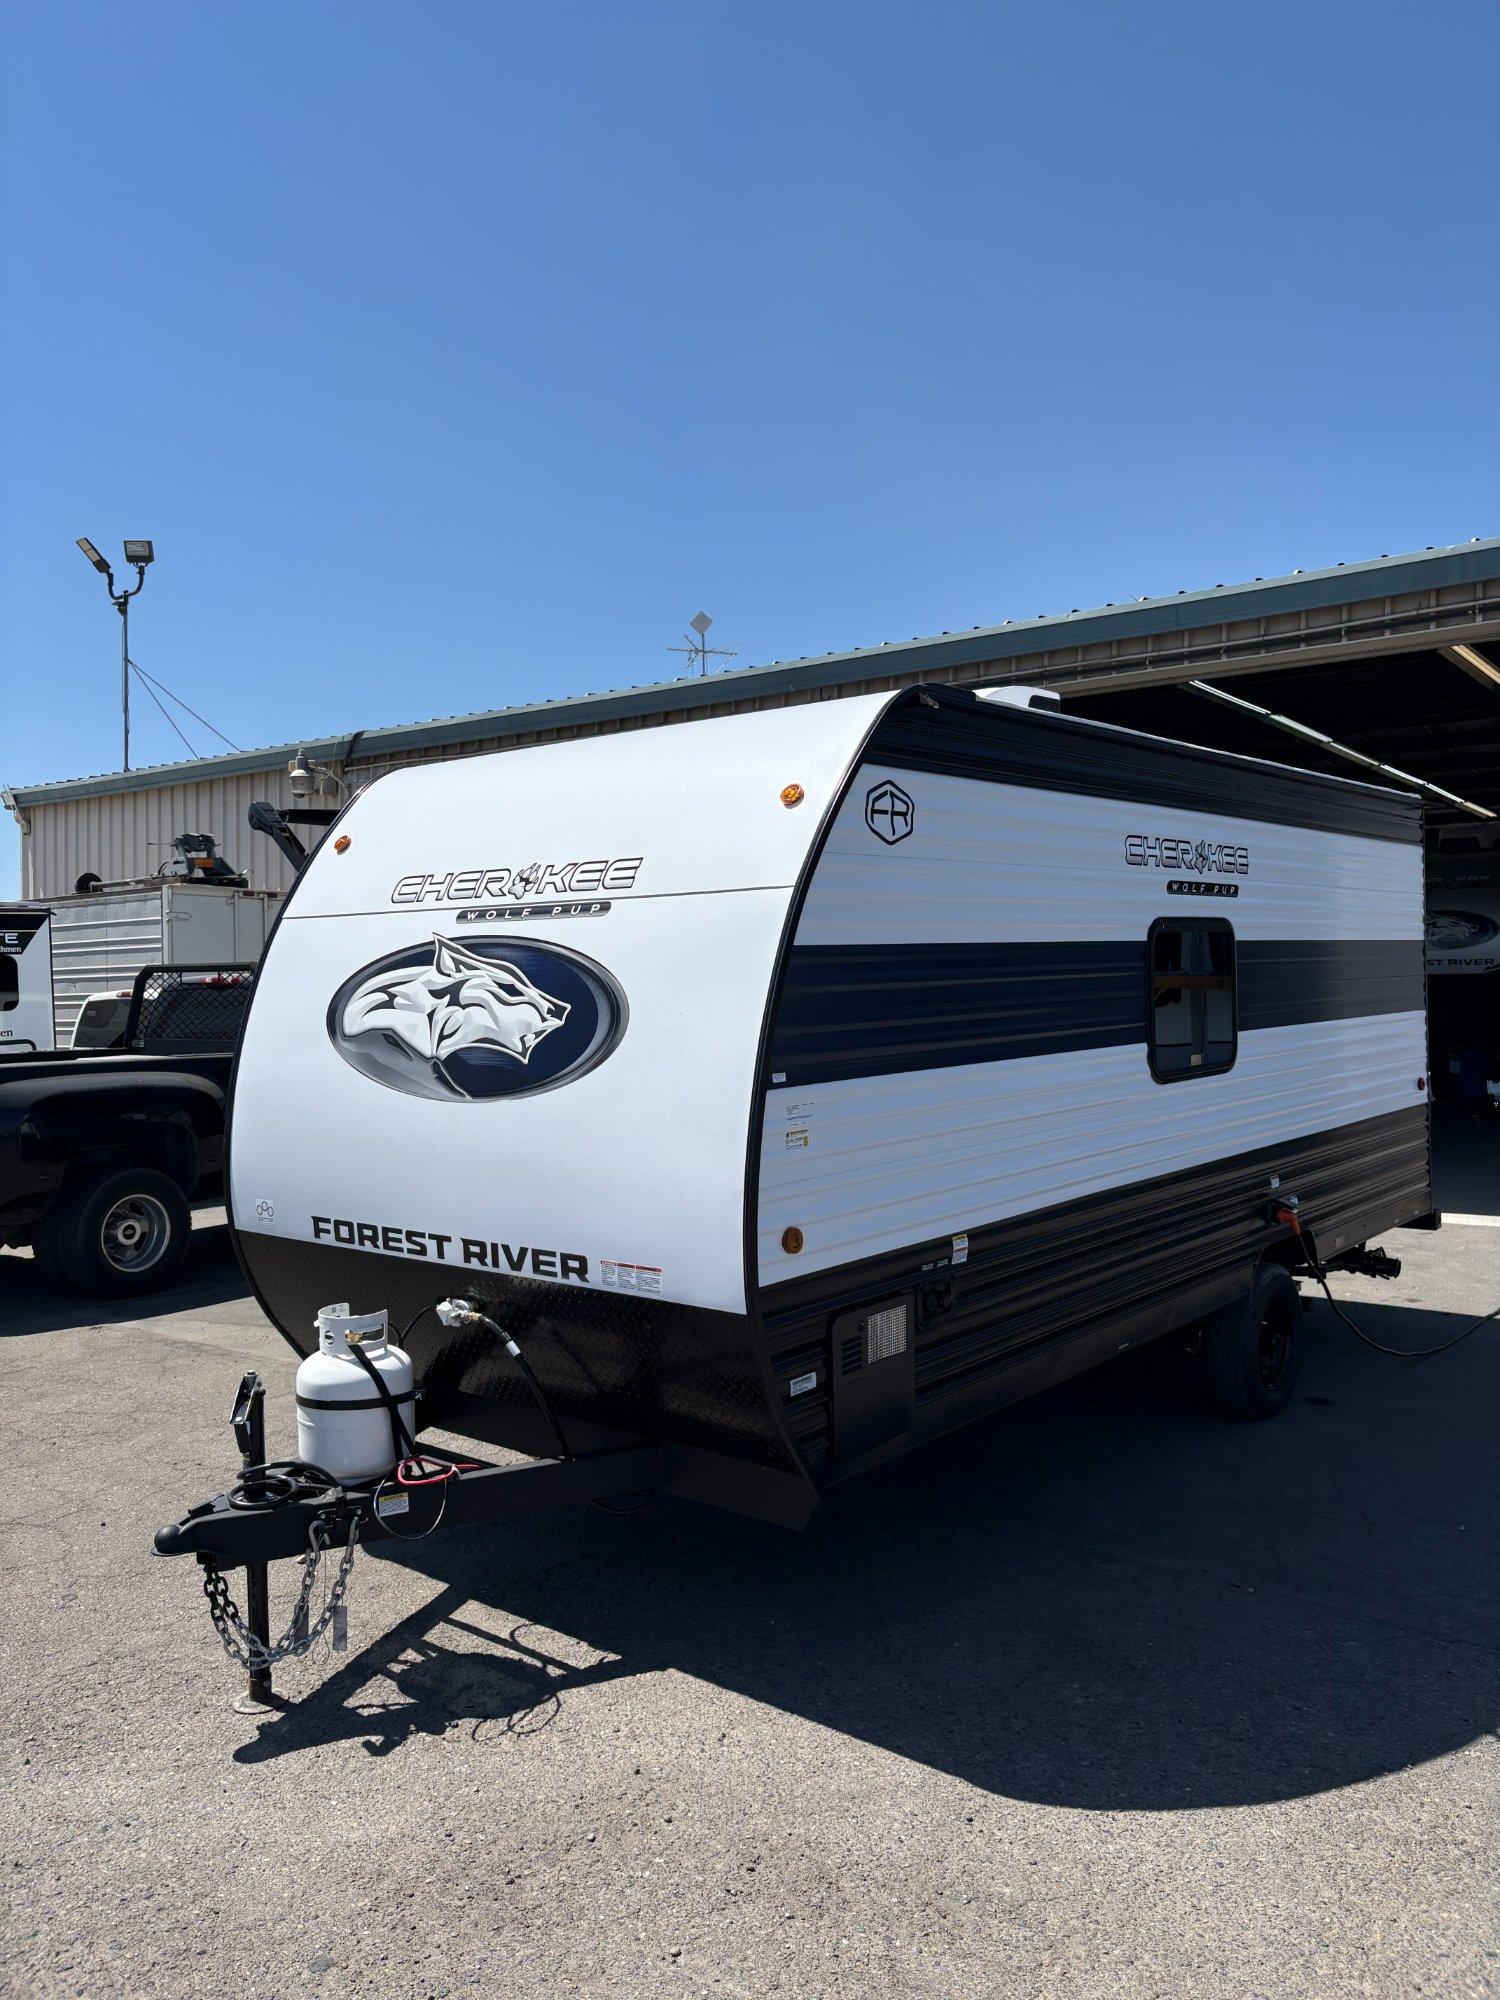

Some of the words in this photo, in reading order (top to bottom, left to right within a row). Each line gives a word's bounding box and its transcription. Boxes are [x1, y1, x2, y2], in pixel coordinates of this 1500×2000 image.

[1125, 835, 1249, 874] CHEROKEE
[391, 857, 644, 904] CHEROKEE
[1171, 882, 1206, 893] WOLF
[1213, 885, 1236, 895] PUP
[466, 908, 532, 922] WOLF
[552, 904, 601, 918] PUP
[1447, 958, 1495, 966] RIVER
[311, 1215, 451, 1260] FOREST
[460, 1237, 590, 1283] RIVER
